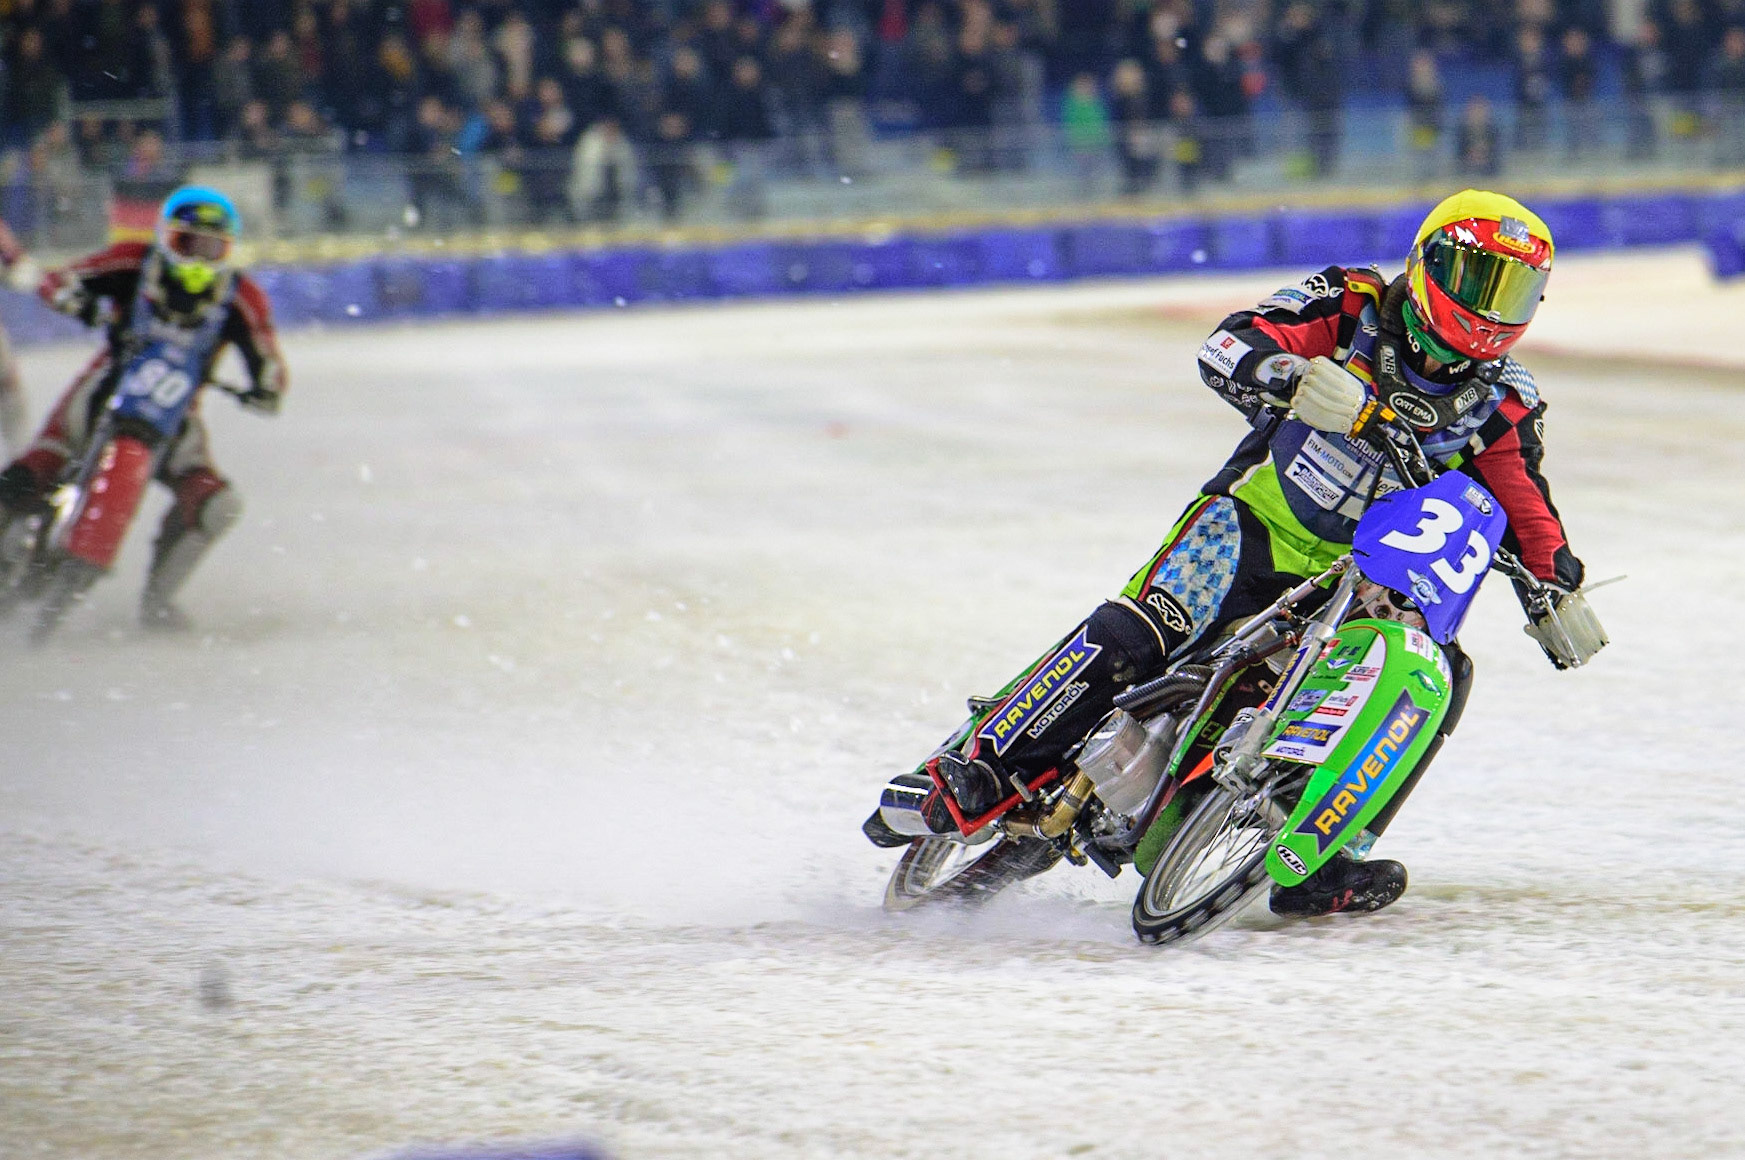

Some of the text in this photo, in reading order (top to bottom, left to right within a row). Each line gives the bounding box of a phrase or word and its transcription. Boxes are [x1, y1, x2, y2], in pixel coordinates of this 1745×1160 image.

[1216, 350, 1235, 370] Fuchs
[1379, 498, 1490, 594] 33
[994, 650, 1085, 739] RAVENOL
[1030, 682, 1088, 737] MOTORÖL
[1282, 725, 1328, 741] RAVENOL
[1314, 711, 1419, 835] RAVENOL
[1279, 849, 1305, 872] HJC
